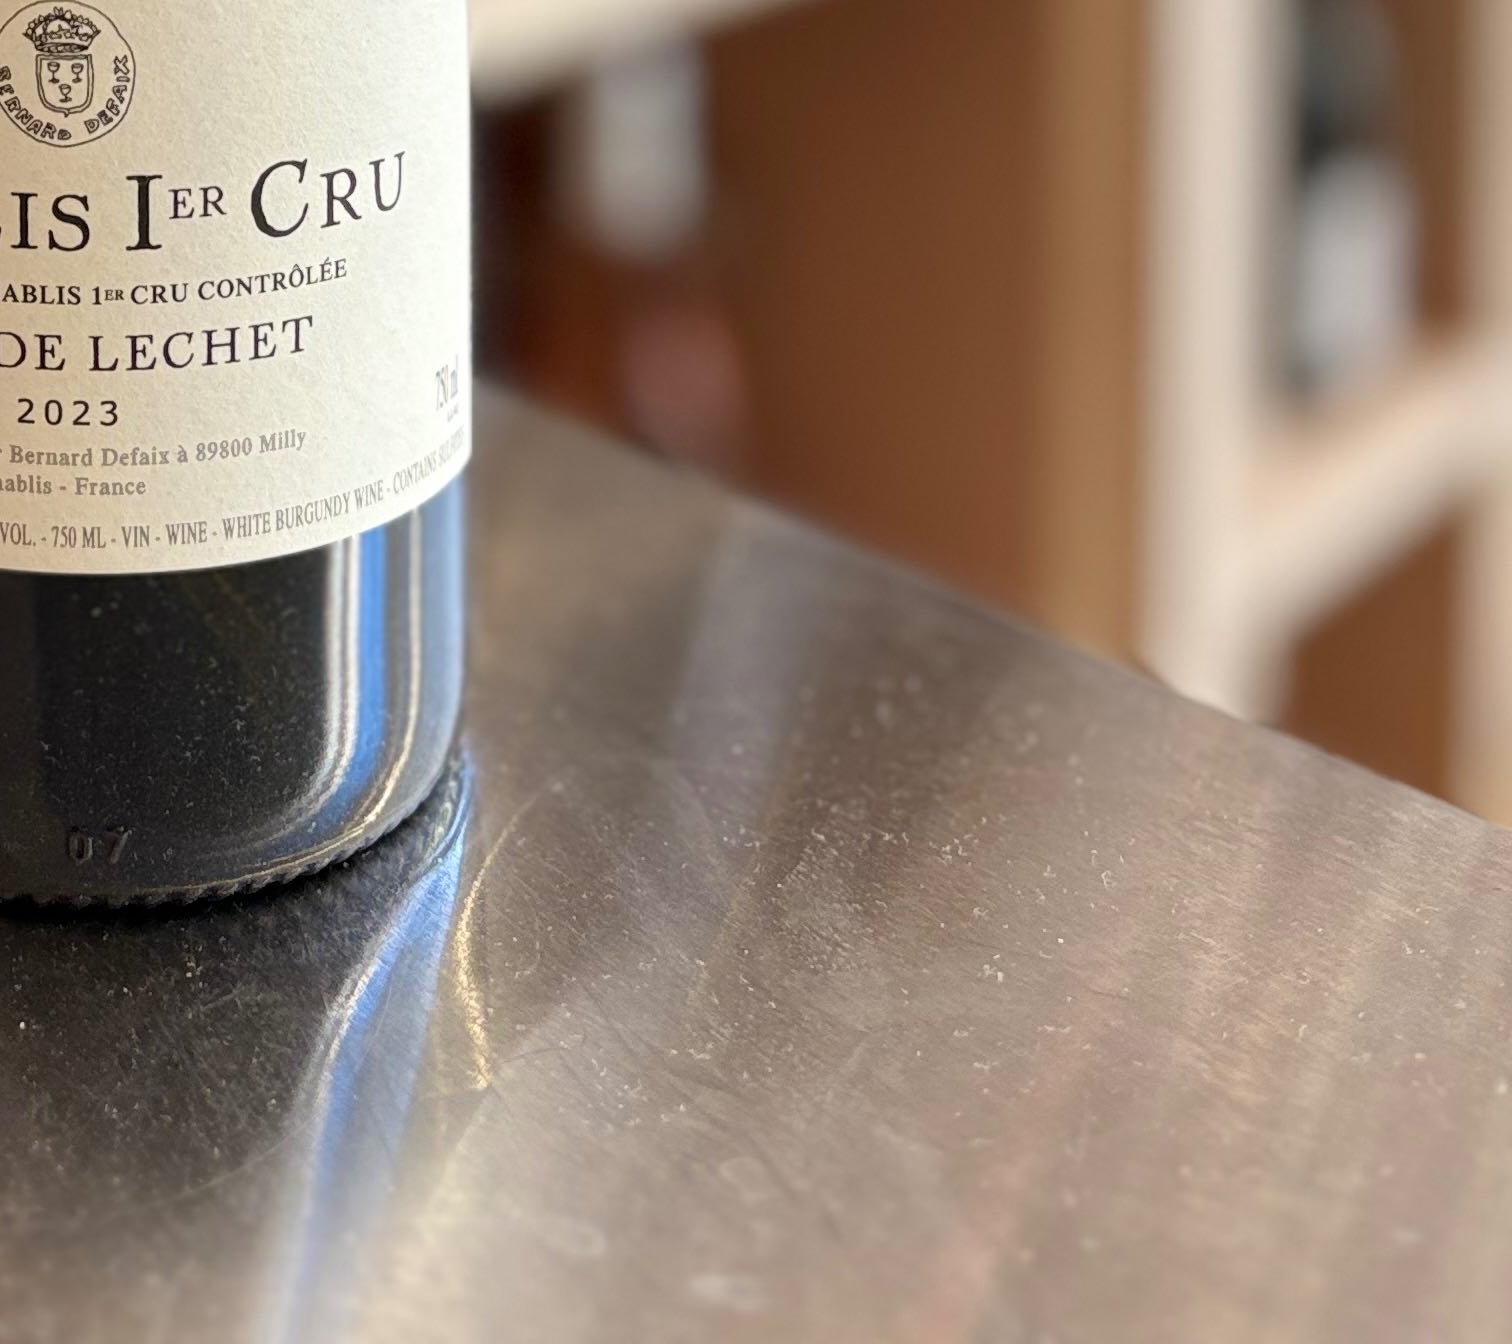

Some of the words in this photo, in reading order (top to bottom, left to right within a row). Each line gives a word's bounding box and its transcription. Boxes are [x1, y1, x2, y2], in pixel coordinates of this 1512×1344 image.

[83, 54, 131, 135] DEFAIX
[250, 150, 406, 239] CRU
[130, 282, 189, 305] CRU
[197, 256, 348, 302] CONTRÔLÉE
[88, 314, 315, 372] LECHET
[16, 397, 119, 427] 2023
[9, 444, 93, 467] Bernard
[100, 445, 171, 468] Defaix
[176, 445, 189, 463] à
[195, 436, 253, 462] 89800
[259, 427, 307, 456] Milly
[75, 475, 147, 497] France
[0, 522, 37, 548] VOL.
[51, 525, 77, 549] 750
[82, 526, 107, 549] ML
[121, 525, 150, 549] VIN
[165, 520, 208, 548] WINE
[221, 511, 271, 542] WHITE
[275, 491, 349, 533] BURGUNDY
[354, 479, 385, 514] WINE
